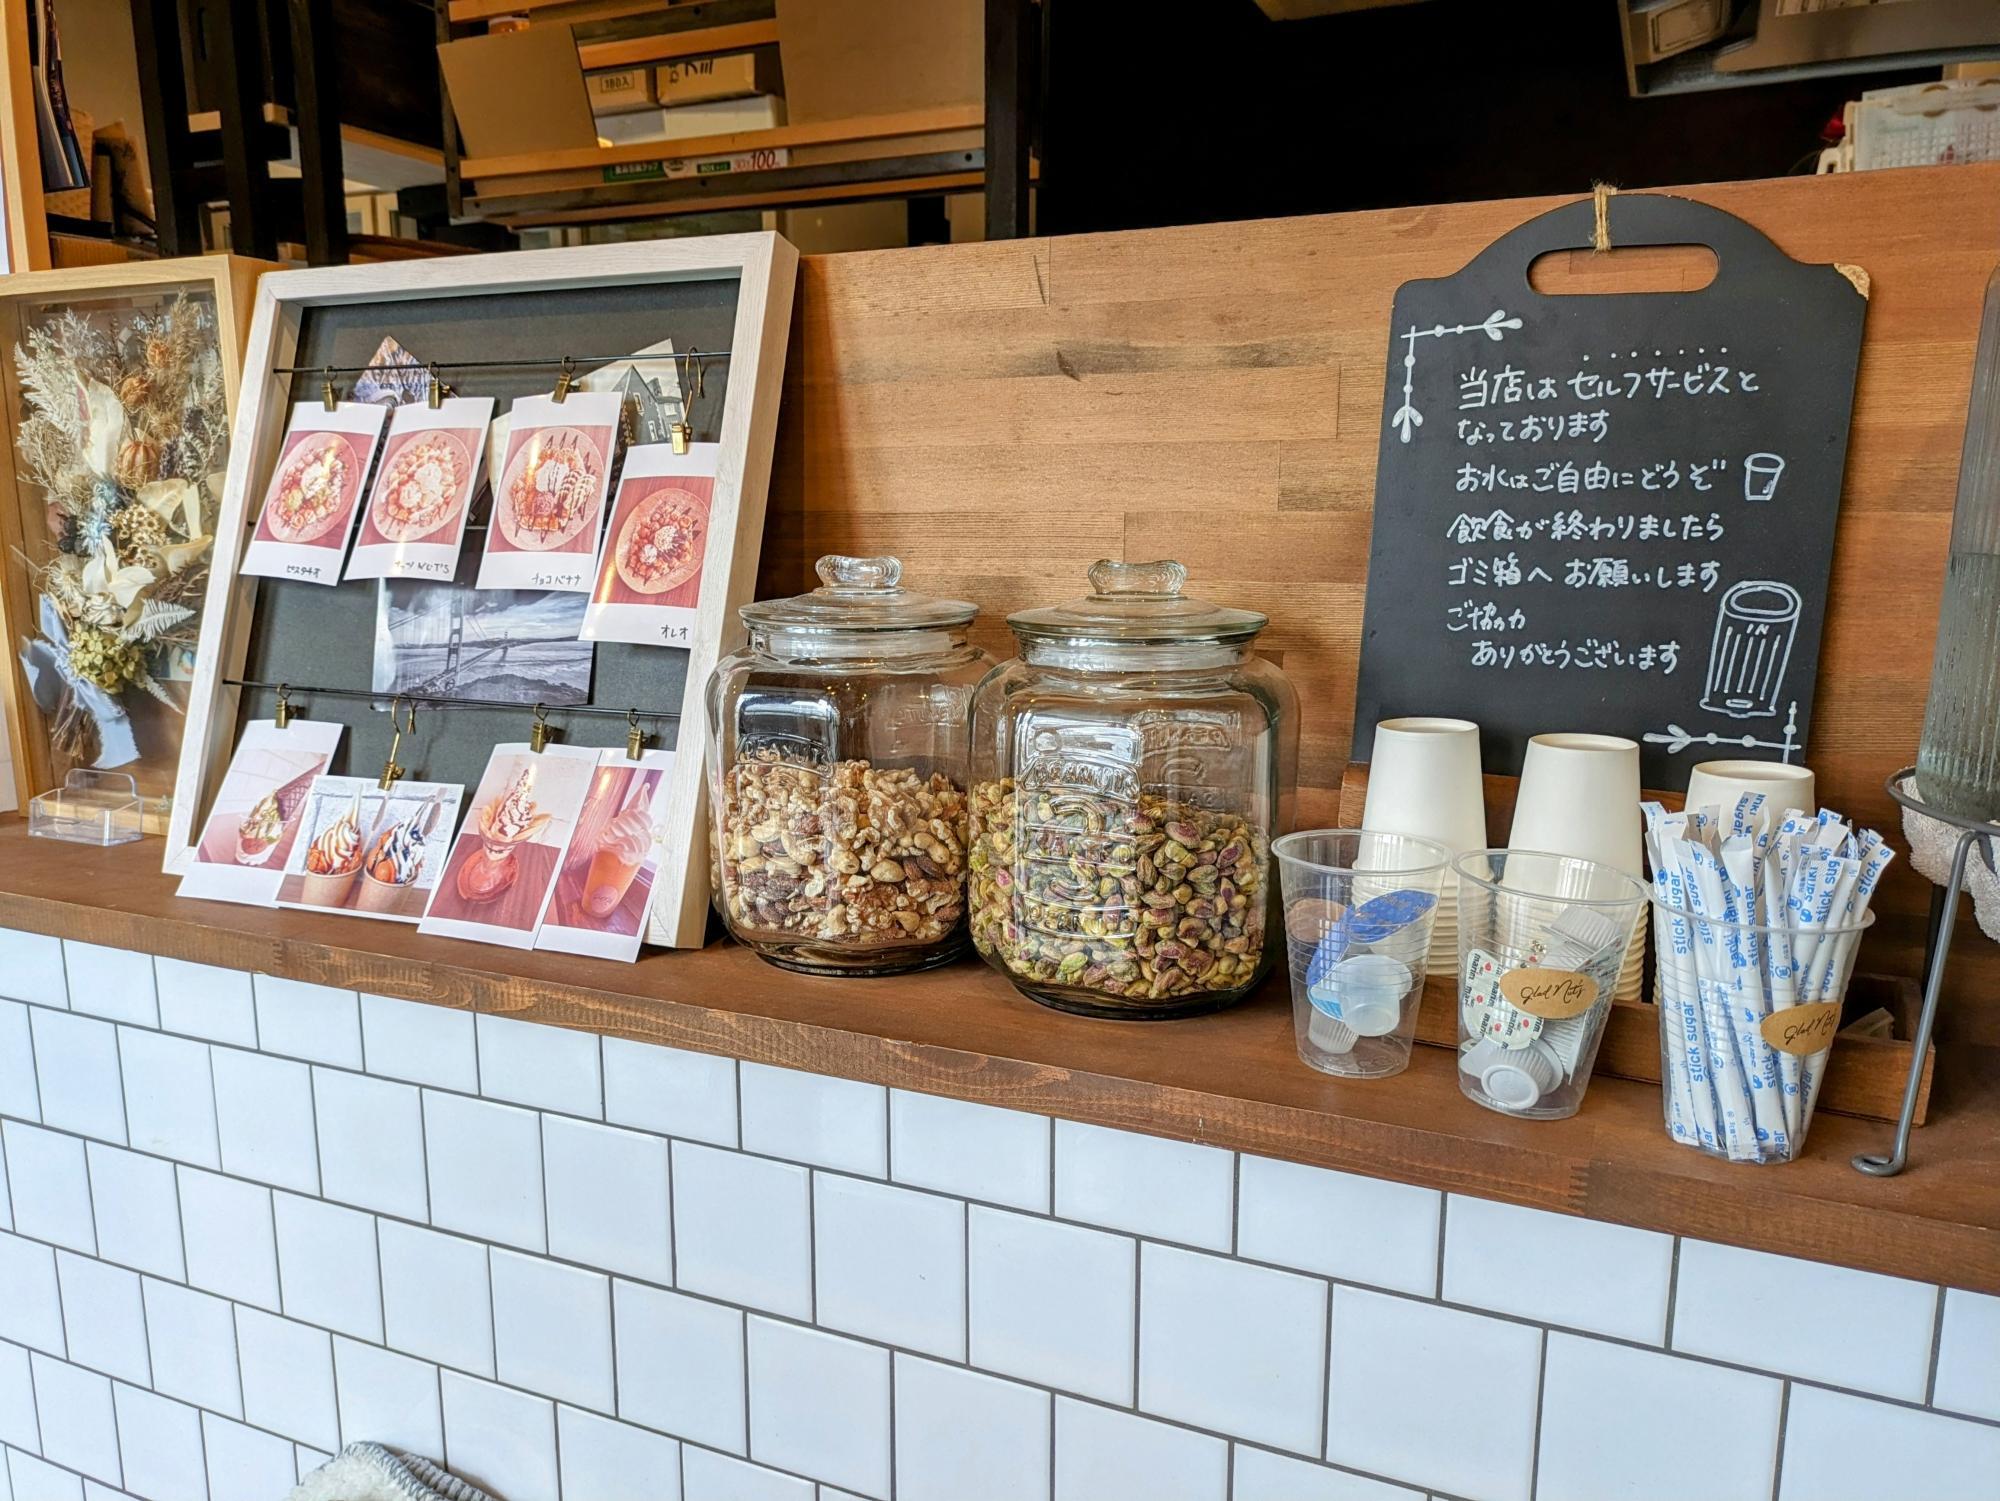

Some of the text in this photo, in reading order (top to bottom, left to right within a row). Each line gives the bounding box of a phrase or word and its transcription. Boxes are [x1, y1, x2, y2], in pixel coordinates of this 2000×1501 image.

[1456, 408, 1610, 446] なっております
[1455, 458, 1727, 494] お水はご自由にどうぞ
[1446, 509, 1725, 544] 飲食が終わりましたら
[660, 624, 689, 640] オレオ
[1446, 599, 1527, 632] ご協力
[1746, 623, 1770, 636] IN
[1470, 639, 1681, 675] ありがとうございます
[1733, 796, 1749, 834] sugar
[1684, 866, 1702, 910] sugar
[1857, 859, 1881, 896] stick
[1670, 871, 1687, 955] stick sugar
[1816, 888, 1834, 923] stick
[1744, 885, 1759, 967] stick sugar
[1682, 1000, 1704, 1083] stick sugar
